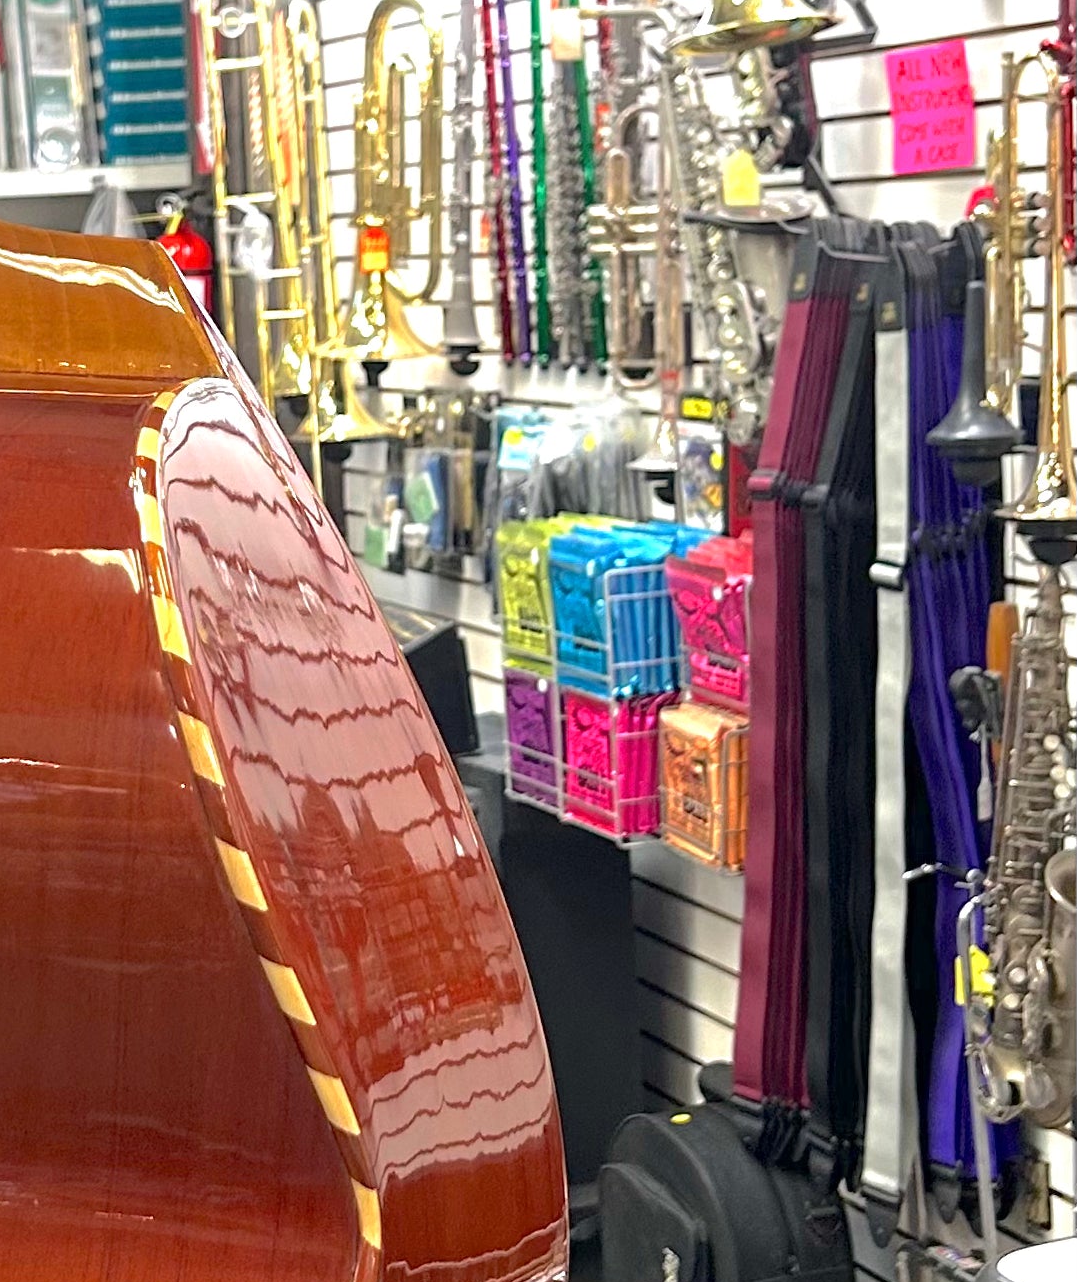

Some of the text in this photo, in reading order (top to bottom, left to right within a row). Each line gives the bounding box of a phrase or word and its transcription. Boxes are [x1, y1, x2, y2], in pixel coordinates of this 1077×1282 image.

[895, 52, 963, 82] ALL NEW
[914, 147, 924, 165] A
